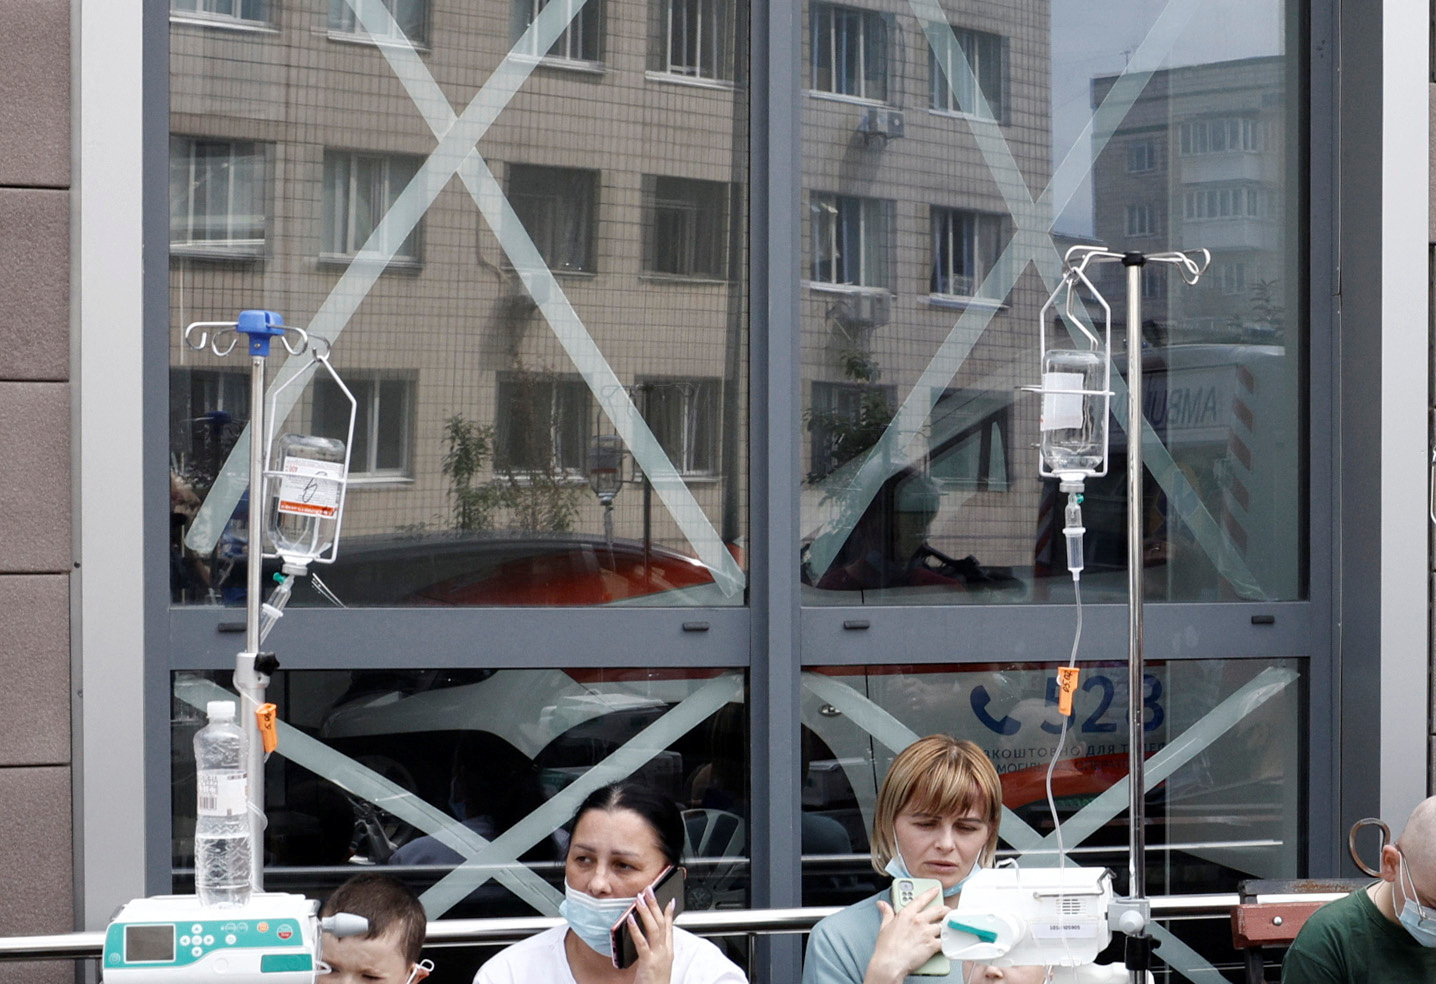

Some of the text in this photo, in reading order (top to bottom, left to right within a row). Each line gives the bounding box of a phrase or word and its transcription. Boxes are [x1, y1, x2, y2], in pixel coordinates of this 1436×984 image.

[1040, 673, 1165, 734] 528
[984, 746, 1080, 759] ЗКОШТОВНО
[1086, 744, 1115, 757] ДЛЯ
